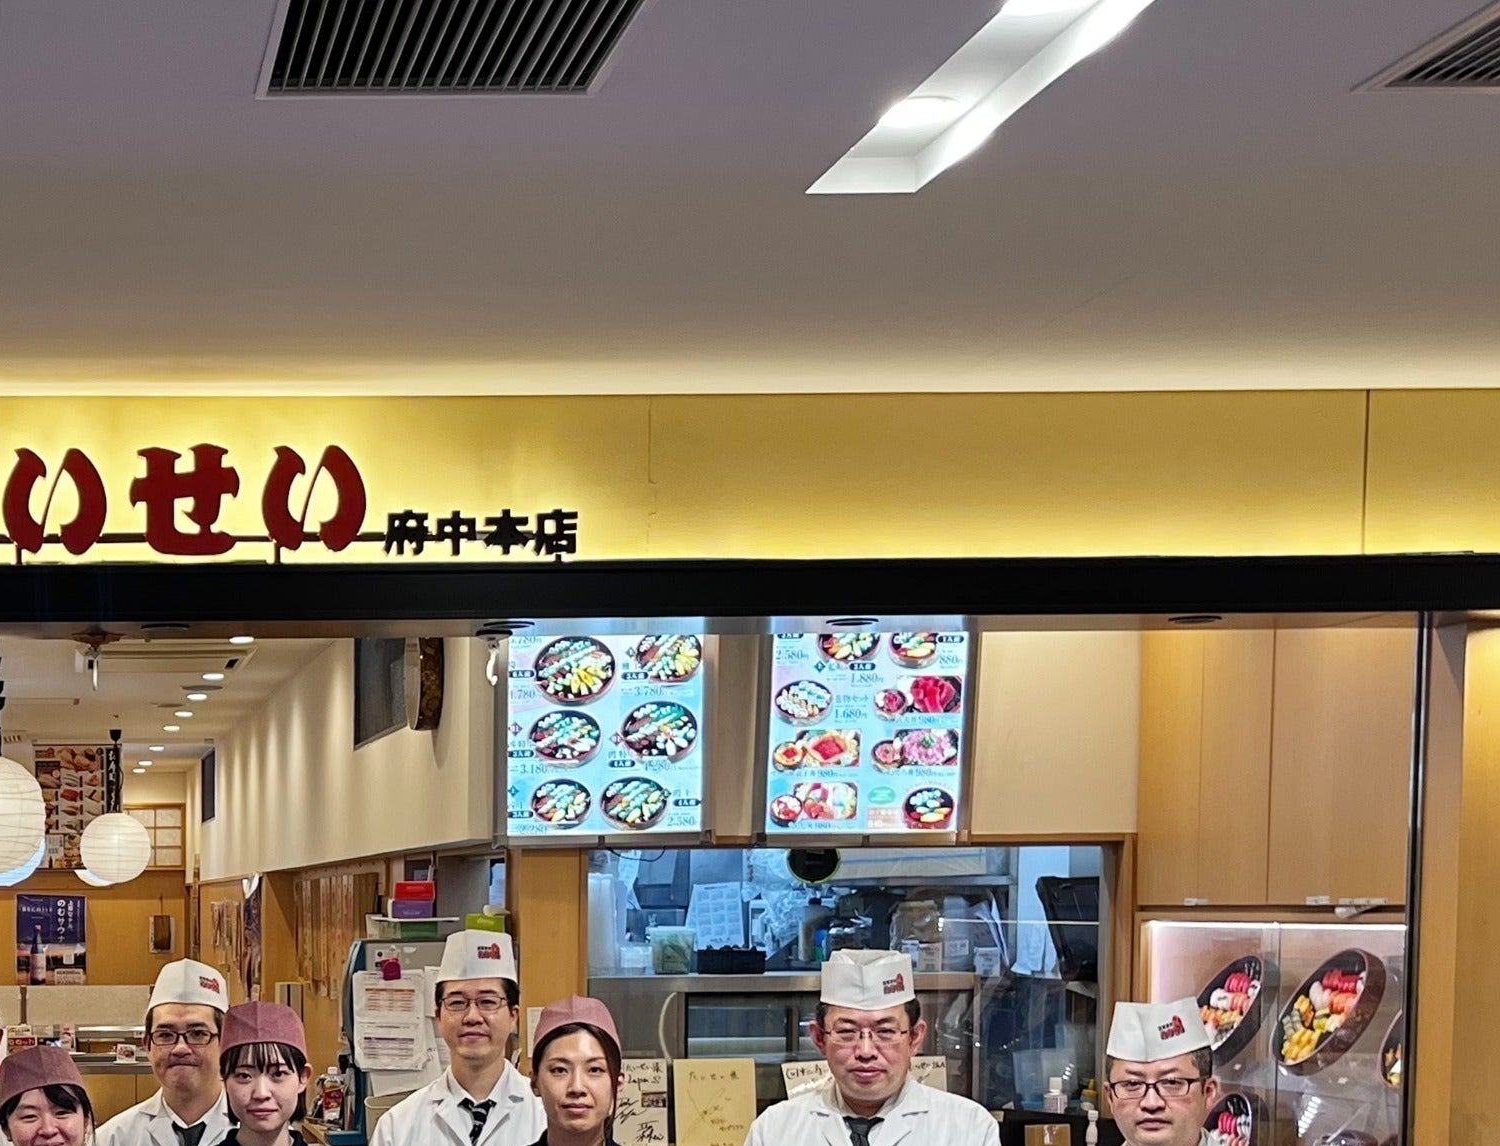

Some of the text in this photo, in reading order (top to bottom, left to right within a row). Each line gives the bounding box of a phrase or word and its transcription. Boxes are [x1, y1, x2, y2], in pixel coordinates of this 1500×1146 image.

[383, 509, 578, 556] 府中本店
[57, 899, 66, 943] のむサウナ
